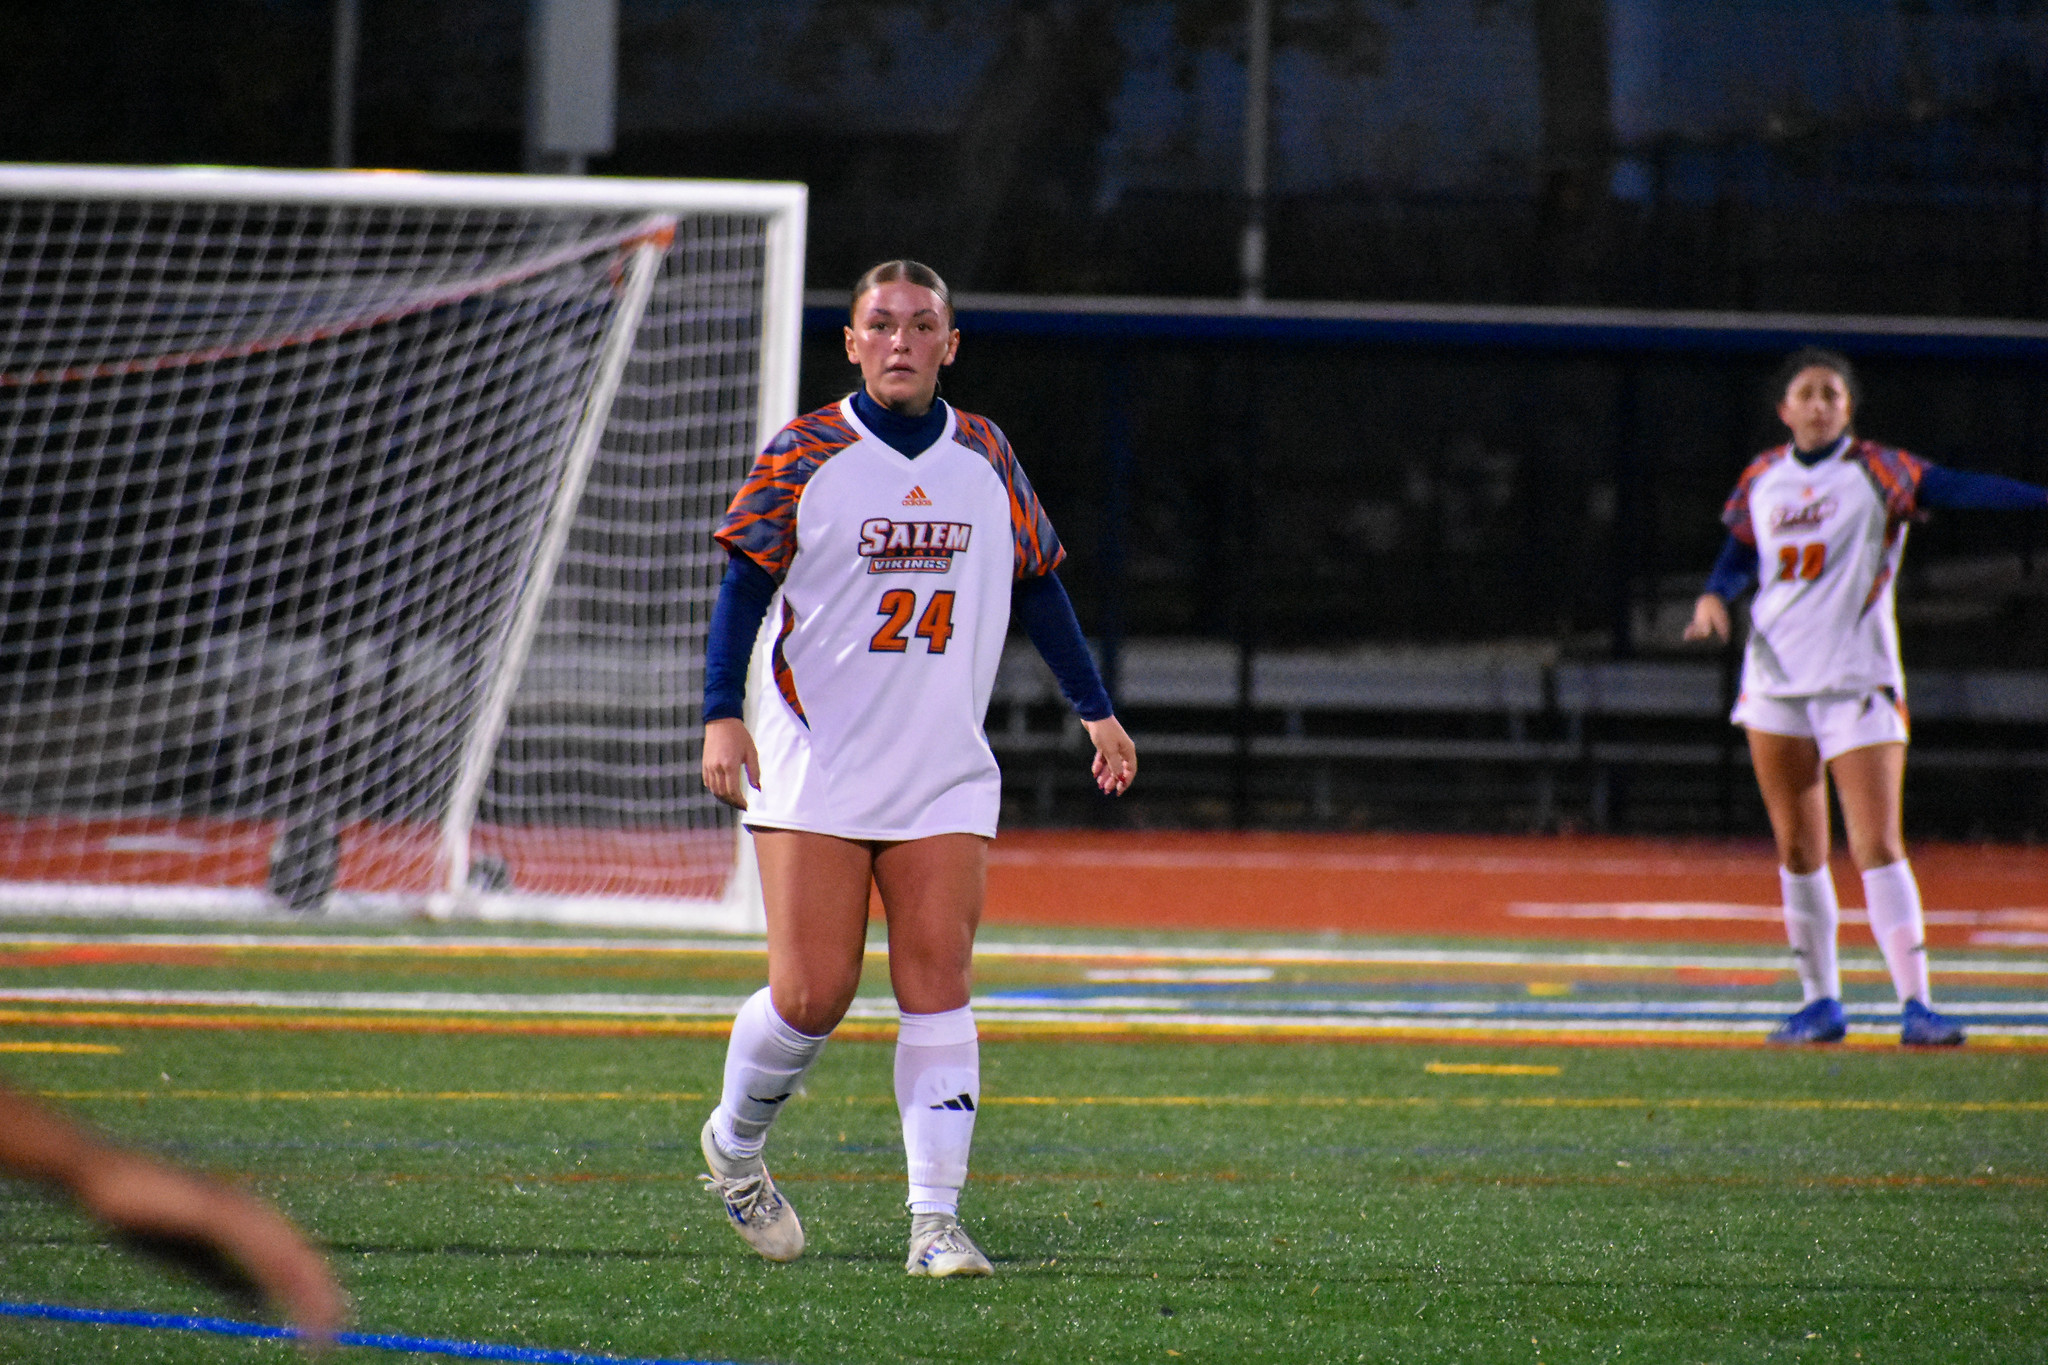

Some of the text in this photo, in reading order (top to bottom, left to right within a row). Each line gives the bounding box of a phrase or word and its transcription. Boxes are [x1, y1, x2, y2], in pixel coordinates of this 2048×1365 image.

[858, 518, 972, 556] SALEM
[873, 559, 948, 570] VIKINGS
[869, 588, 956, 655] 24
